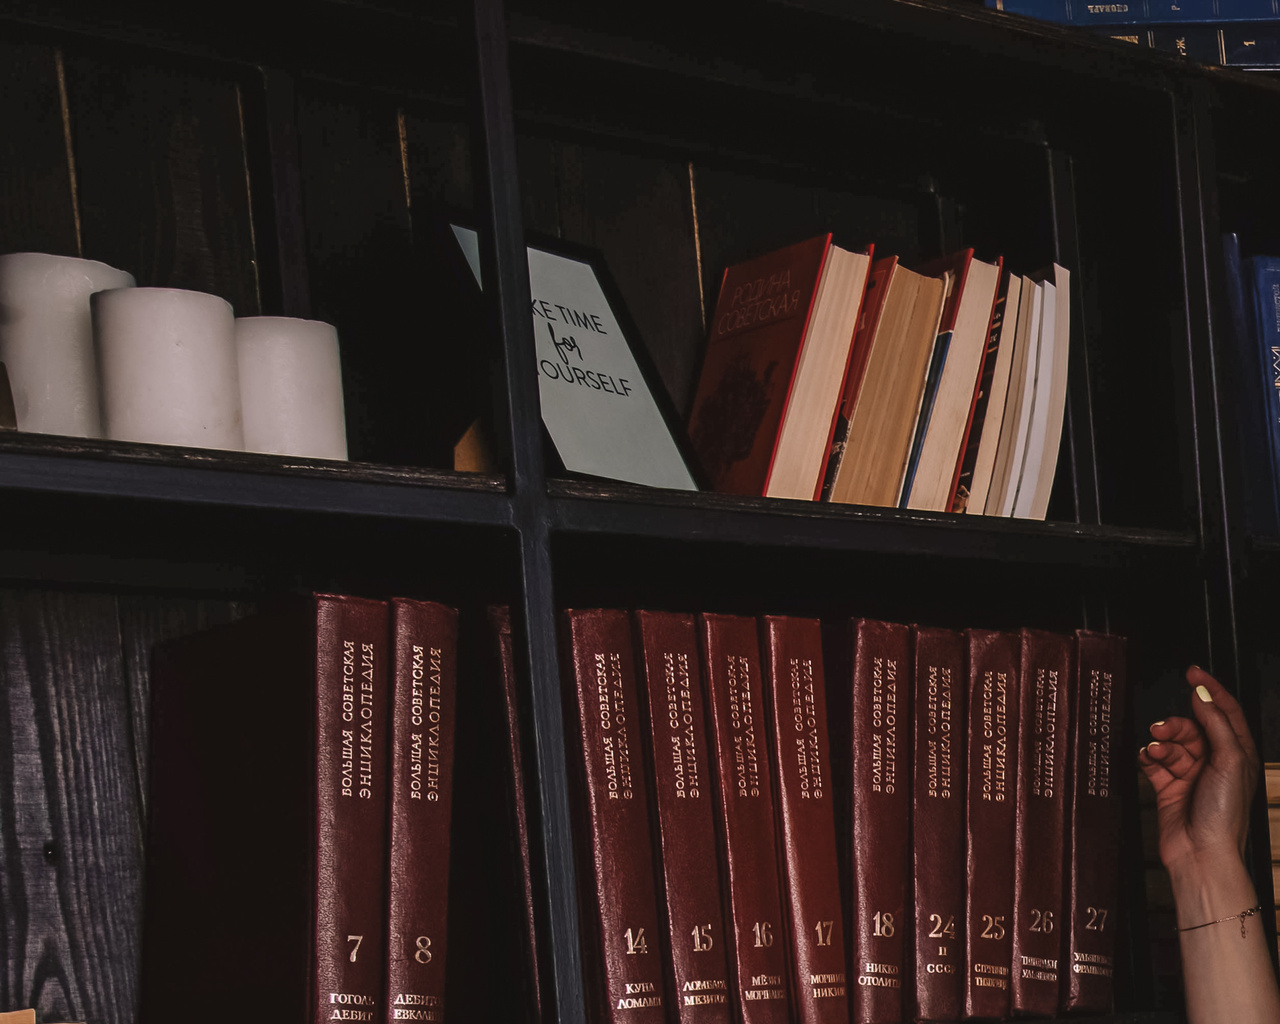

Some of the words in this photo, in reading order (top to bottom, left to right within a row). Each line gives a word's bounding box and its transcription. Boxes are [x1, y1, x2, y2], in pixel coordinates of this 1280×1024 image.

[1243, 39, 1257, 48] 1
[547, 322, 585, 365] for
[555, 304, 608, 335] TIME
[717, 289, 802, 335] СОВЕТСКАЯ
[536, 359, 632, 398] OURSELF
[342, 641, 355, 722] СОВЕТСКАЯ
[411, 645, 424, 726] СОВЕТСКАЯ
[594, 653, 611, 730] СОВЕТСКАЯ
[663, 653, 680, 729] СОВЕТСКАЯ
[727, 655, 741, 729] СОВЕТСКАЯ
[790, 658, 804, 732] СОВЕТСКАЯ
[872, 657, 883, 728] СОВЕТСКАЯ
[928, 666, 938, 735] СОВЕТСКАЯ
[983, 671, 993, 738] СОВЕТСКАЯ
[1089, 669, 1100, 736] СОВЕТСКАЯ
[359, 643, 374, 799] ЭНЦИКЛОПЕДИЯ
[427, 647, 442, 802] ЭНЦИКЛОПЕДИЯ
[610, 653, 633, 800] ЭНЦИКЛОПЕДИЯ
[677, 653, 699, 799] ЭНЦИКЛОПЕДИЯ
[739, 656, 760, 797] ЭНЦИКЛОПЕДИЯ
[802, 660, 822, 799] ЭНЦИКЛОПЕДИЯ
[885, 660, 897, 794] ЭНЦИКЛОПЕДИЯ
[941, 668, 951, 798] ЭНЦИКЛОПЕДИЯ
[995, 672, 1007, 802] ЭНЦИКЛОПЕДИЯ
[1044, 671, 1058, 798] ЭНЦИКЛОПЕДИЯ
[1100, 672, 1112, 798] ЭНЦИКЛОПЕДИЯ
[342, 729, 353, 797] БОЛЬШАЯ
[410, 733, 423, 800] БОЛЬШАЯ
[602, 737, 618, 800] БОЛЬШАЯ
[671, 736, 686, 799] БОЛЬШАЯ
[732, 736, 748, 797] БОЛЬШАЯ
[796, 738, 811, 799] БОЛЬШАЯ
[872, 734, 882, 793] БОЛЬШАЯ
[928, 740, 937, 797] БОЛЬШАЯ
[982, 744, 992, 801] БОЛЬШАЯ
[1088, 741, 1098, 796] БОЛЬШАЯ
[345, 935, 364, 963] 7
[414, 935, 432, 964] 8
[624, 927, 648, 954] 14
[691, 924, 714, 952] 15
[752, 922, 773, 948] 16
[814, 920, 834, 947] 17
[872, 911, 895, 938] 18
[928, 914, 955, 939] 24
[980, 915, 1005, 940] 25
[1029, 909, 1054, 934] 26
[1085, 906, 1108, 932] 27
[625, 982, 655, 994] КУНА
